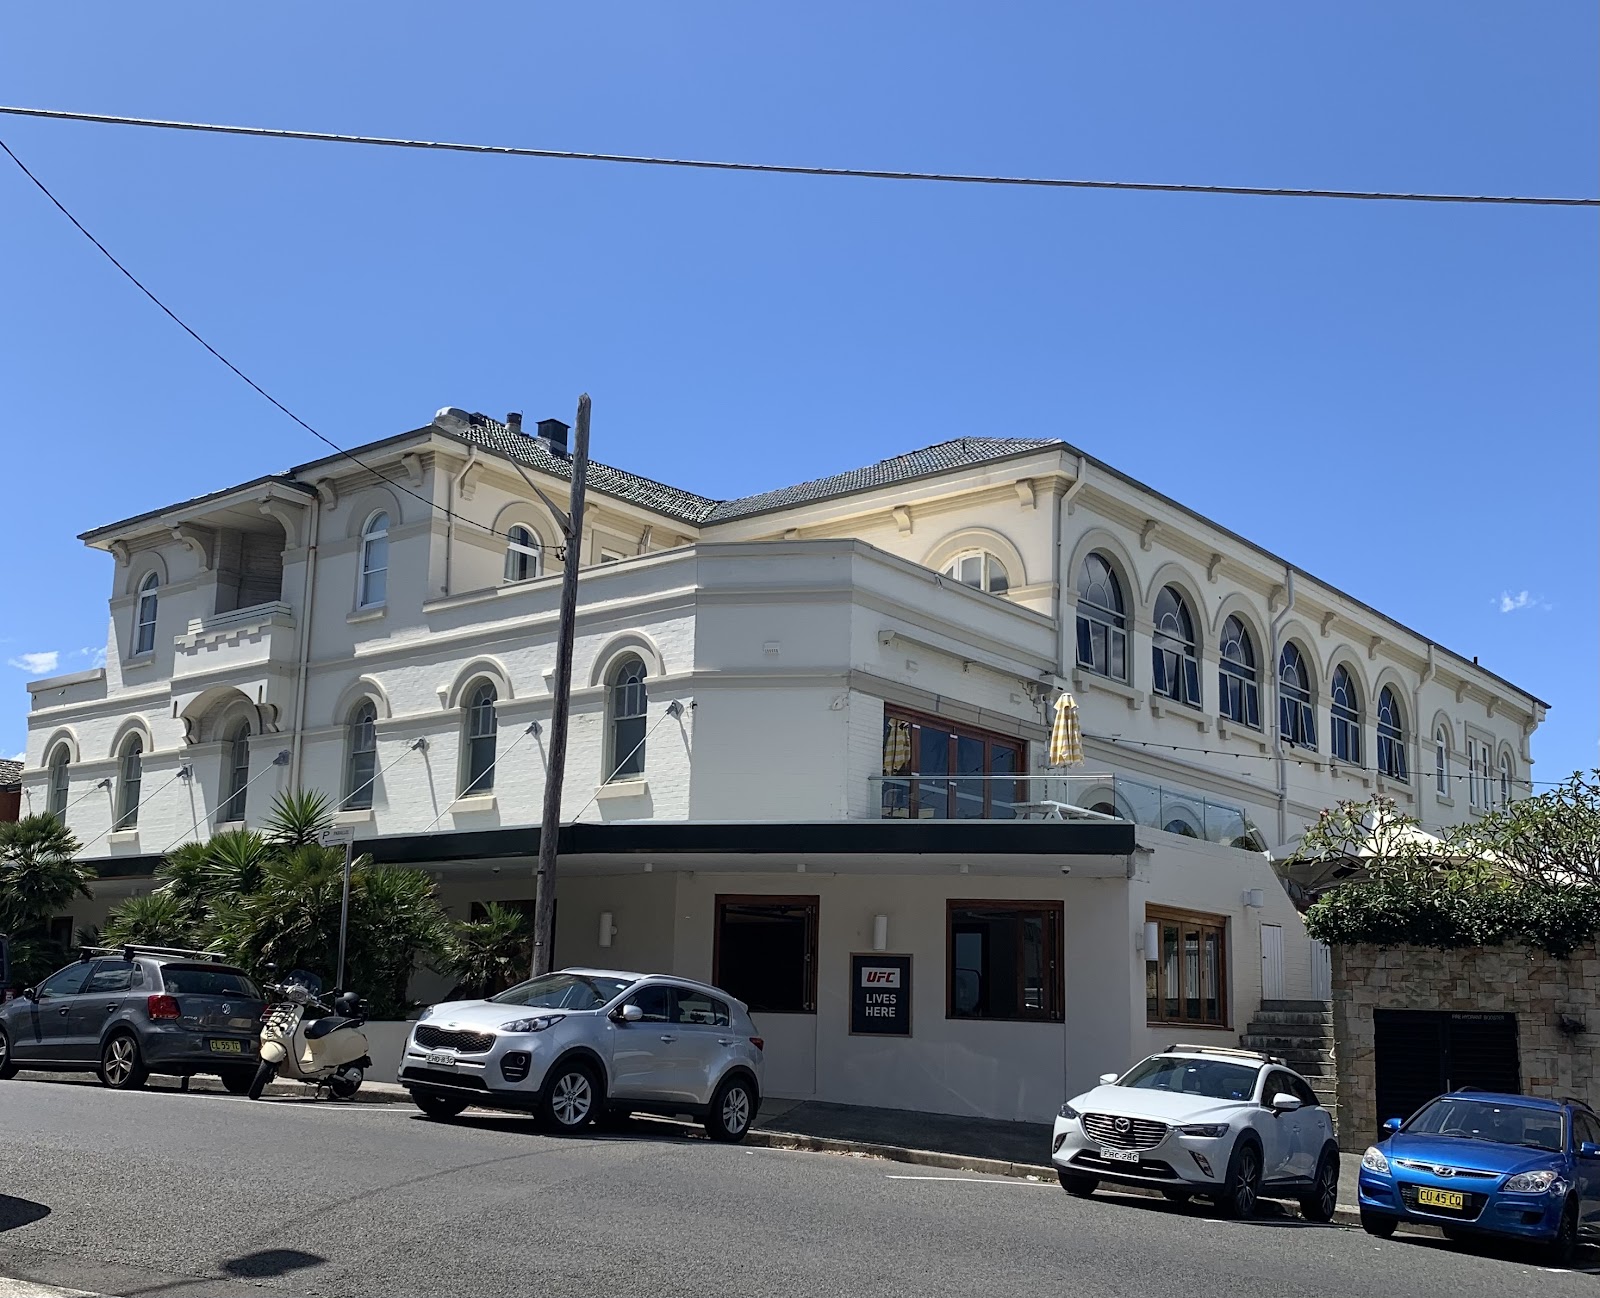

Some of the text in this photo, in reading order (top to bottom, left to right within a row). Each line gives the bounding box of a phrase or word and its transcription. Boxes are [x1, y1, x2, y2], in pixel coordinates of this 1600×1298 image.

[322, 830, 331, 840] P
[866, 971, 896, 983] UFC
[866, 993, 897, 1004] LIVES
[865, 1006, 896, 1017] HERE
